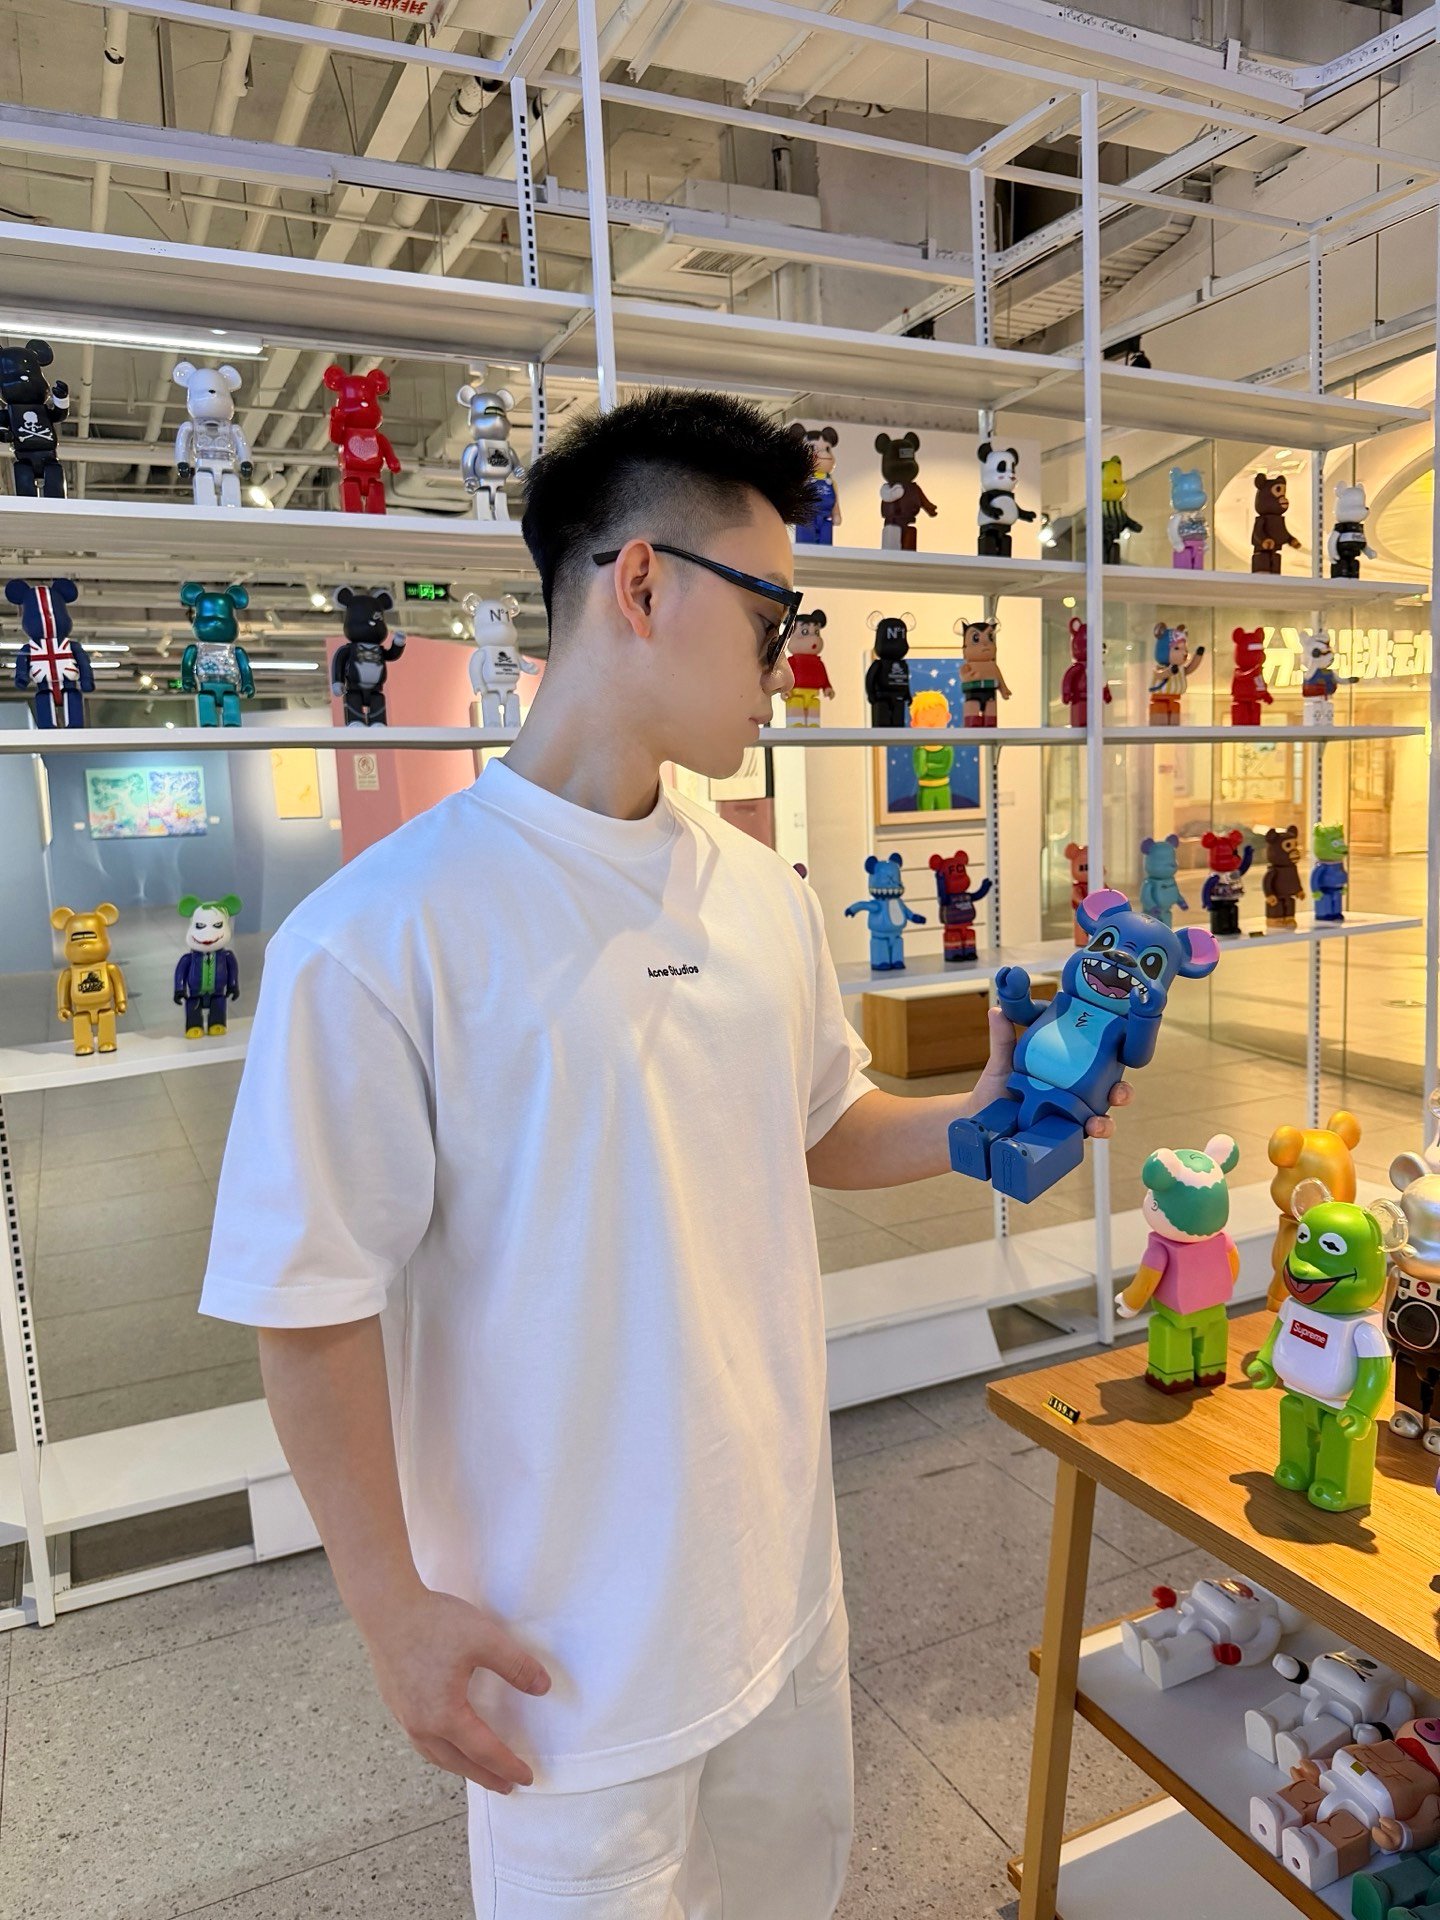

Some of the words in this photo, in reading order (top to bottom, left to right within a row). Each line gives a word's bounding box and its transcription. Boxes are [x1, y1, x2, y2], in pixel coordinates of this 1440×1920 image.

[647, 967, 669, 978] Acne
[668, 964, 699, 976] Studios
[1293, 1322, 1326, 1344] Supreme
